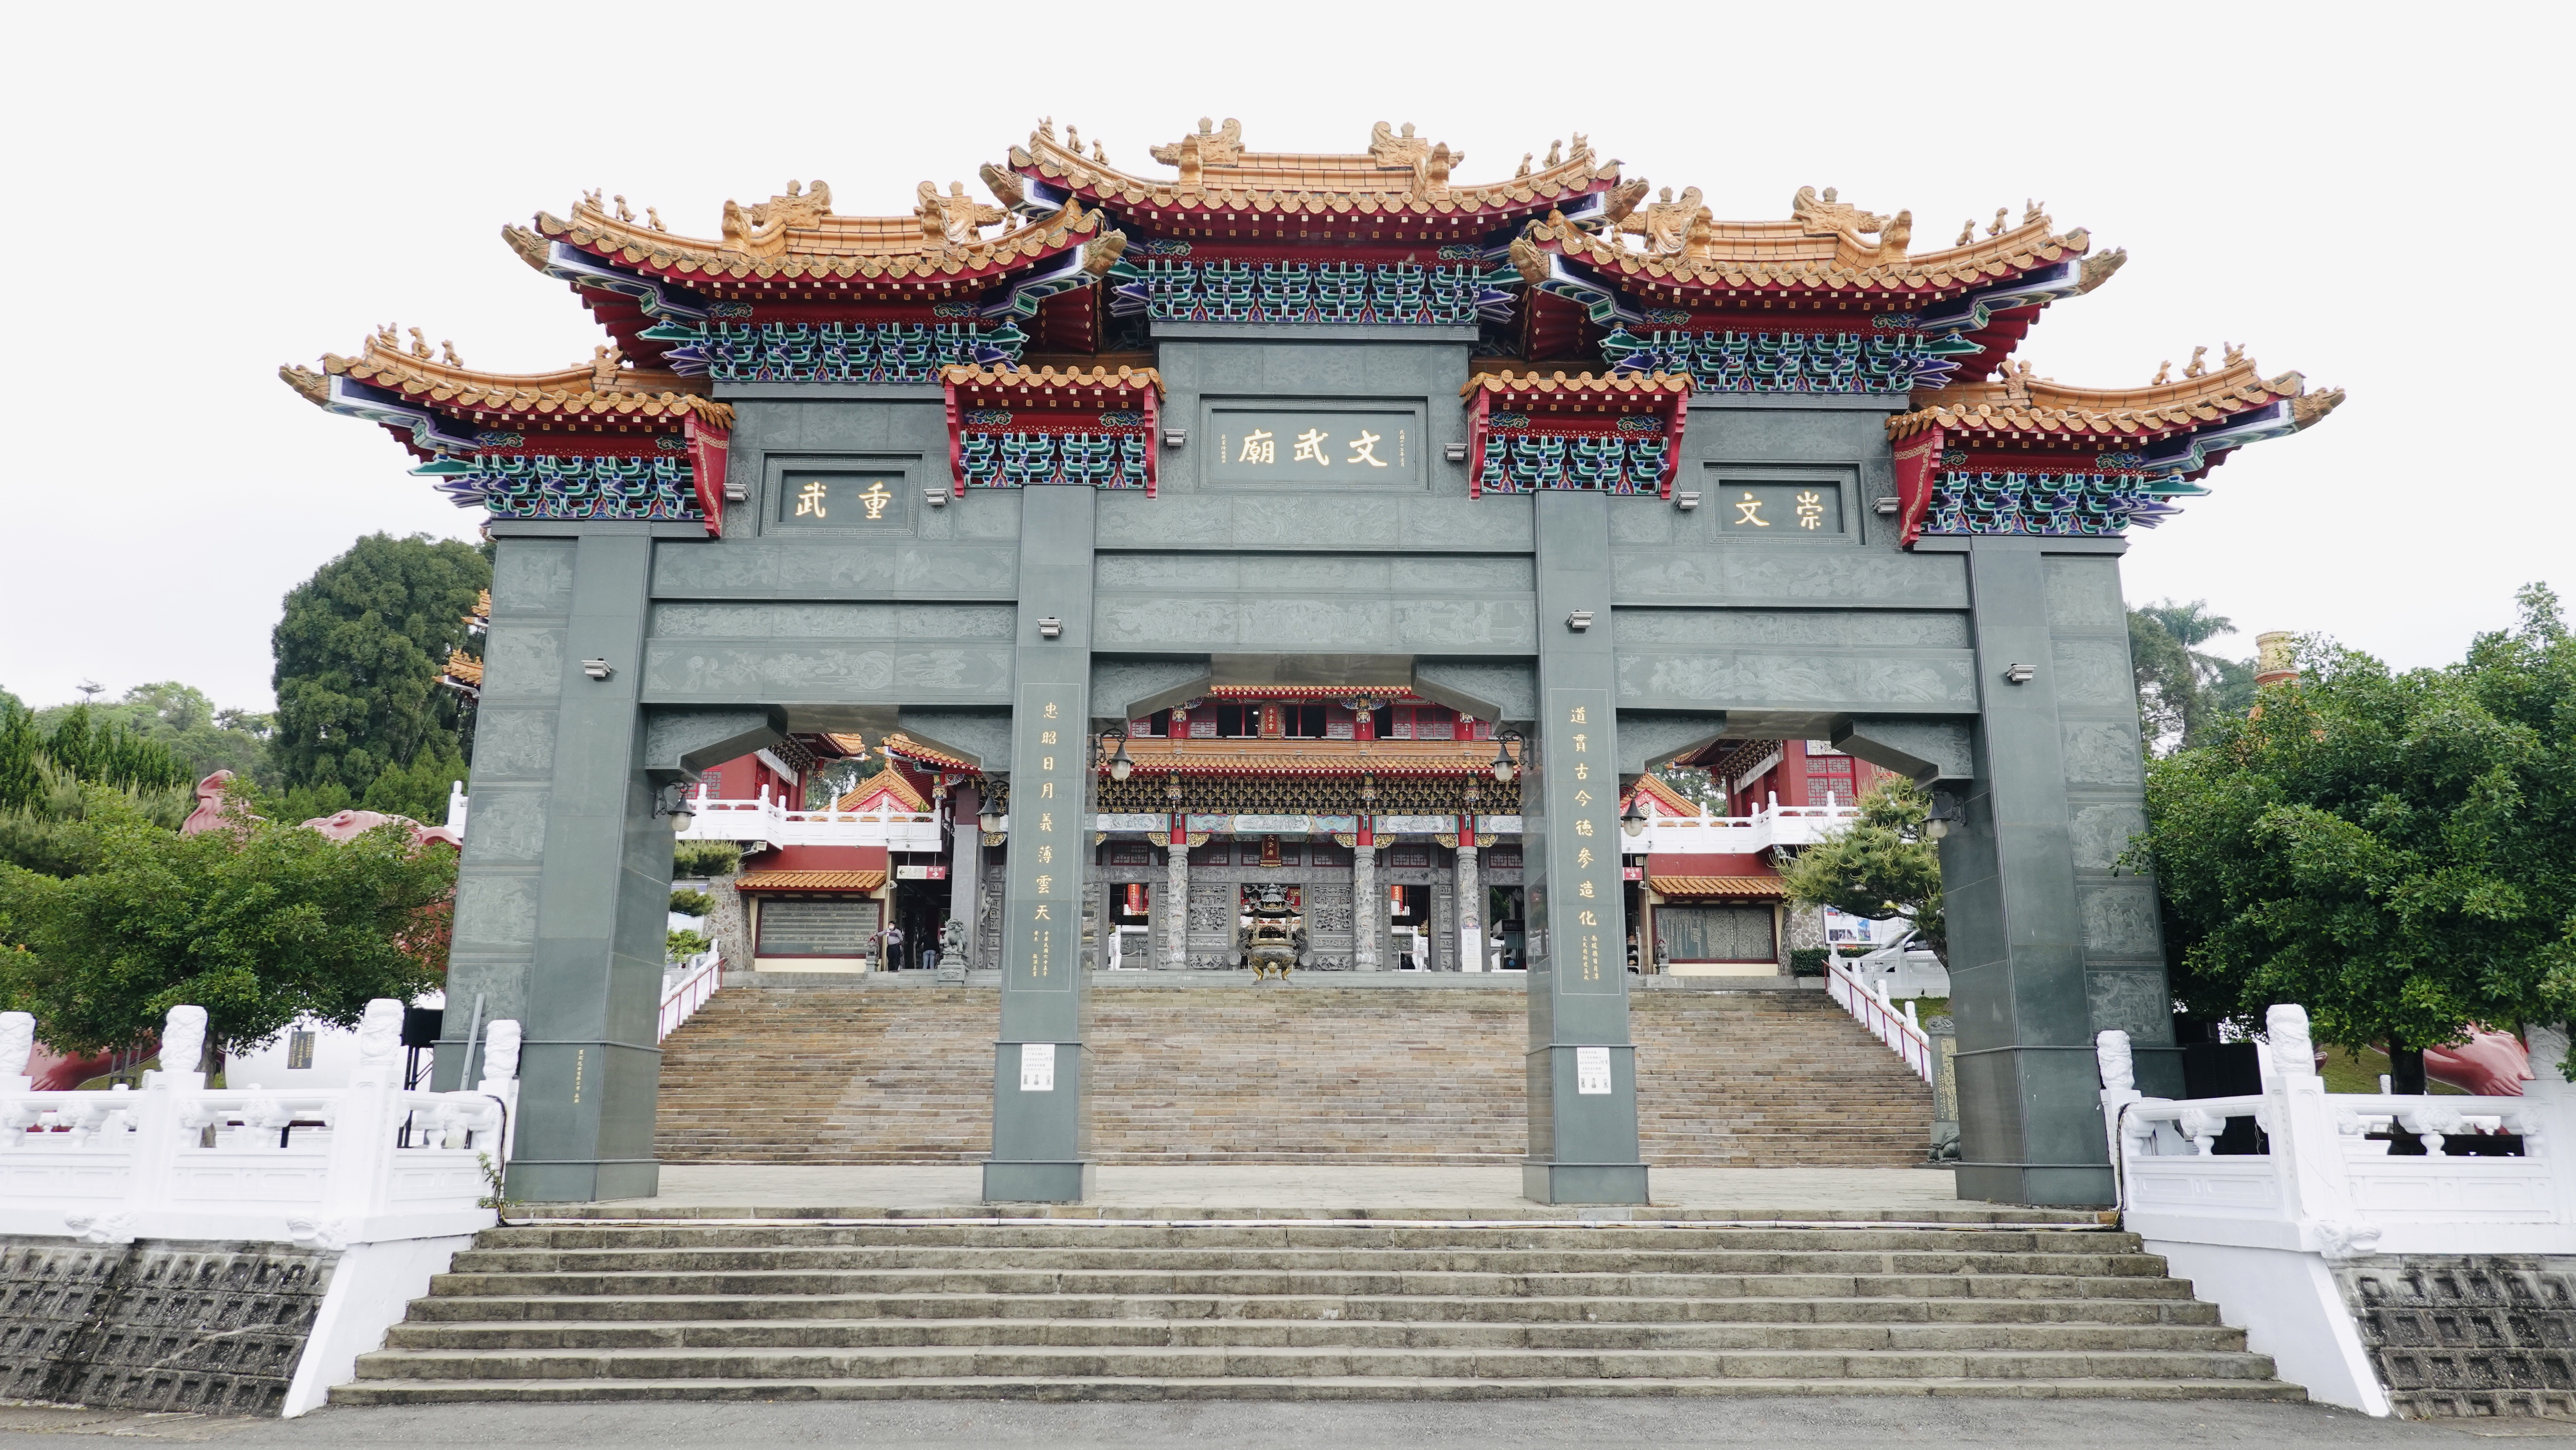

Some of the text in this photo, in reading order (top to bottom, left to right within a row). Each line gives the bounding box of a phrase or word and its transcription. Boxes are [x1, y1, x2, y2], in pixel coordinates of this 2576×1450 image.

[1238, 428, 1388, 467] 文武廟
[795, 481, 892, 519] 重武
[1735, 491, 1823, 530] 崇文
[1035, 701, 1059, 920] 忠昭日月義薄雲天
